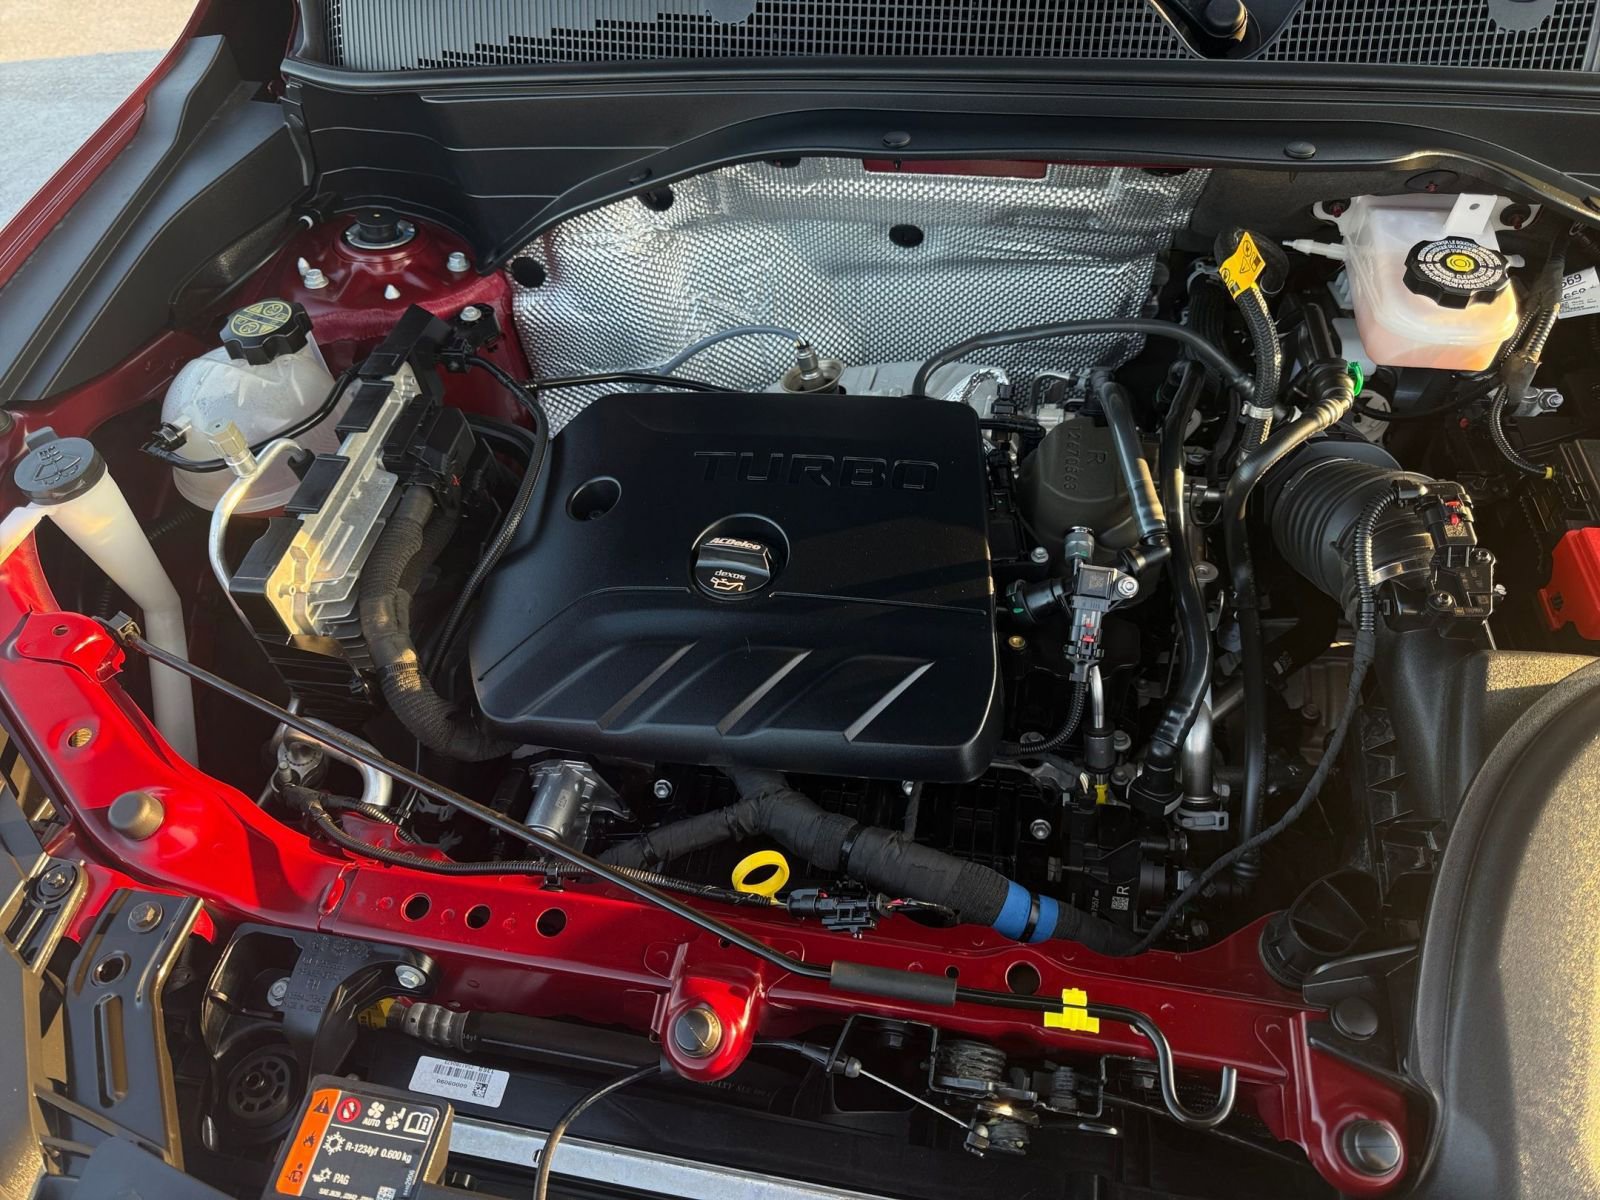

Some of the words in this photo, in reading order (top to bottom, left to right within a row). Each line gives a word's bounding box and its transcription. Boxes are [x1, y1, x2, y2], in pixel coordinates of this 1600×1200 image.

[1087, 450, 1108, 465] R
[694, 451, 940, 491] TURBO
[709, 536, 762, 551] ACDelco
[714, 569, 747, 582] dexos
[1116, 885, 1130, 896] R
[362, 1117, 381, 1128] AUTO
[344, 1141, 379, 1158] R-1234yf
[380, 1148, 402, 1161] 0.600
[401, 1154, 413, 1164] kg
[332, 1173, 351, 1186] PAG
